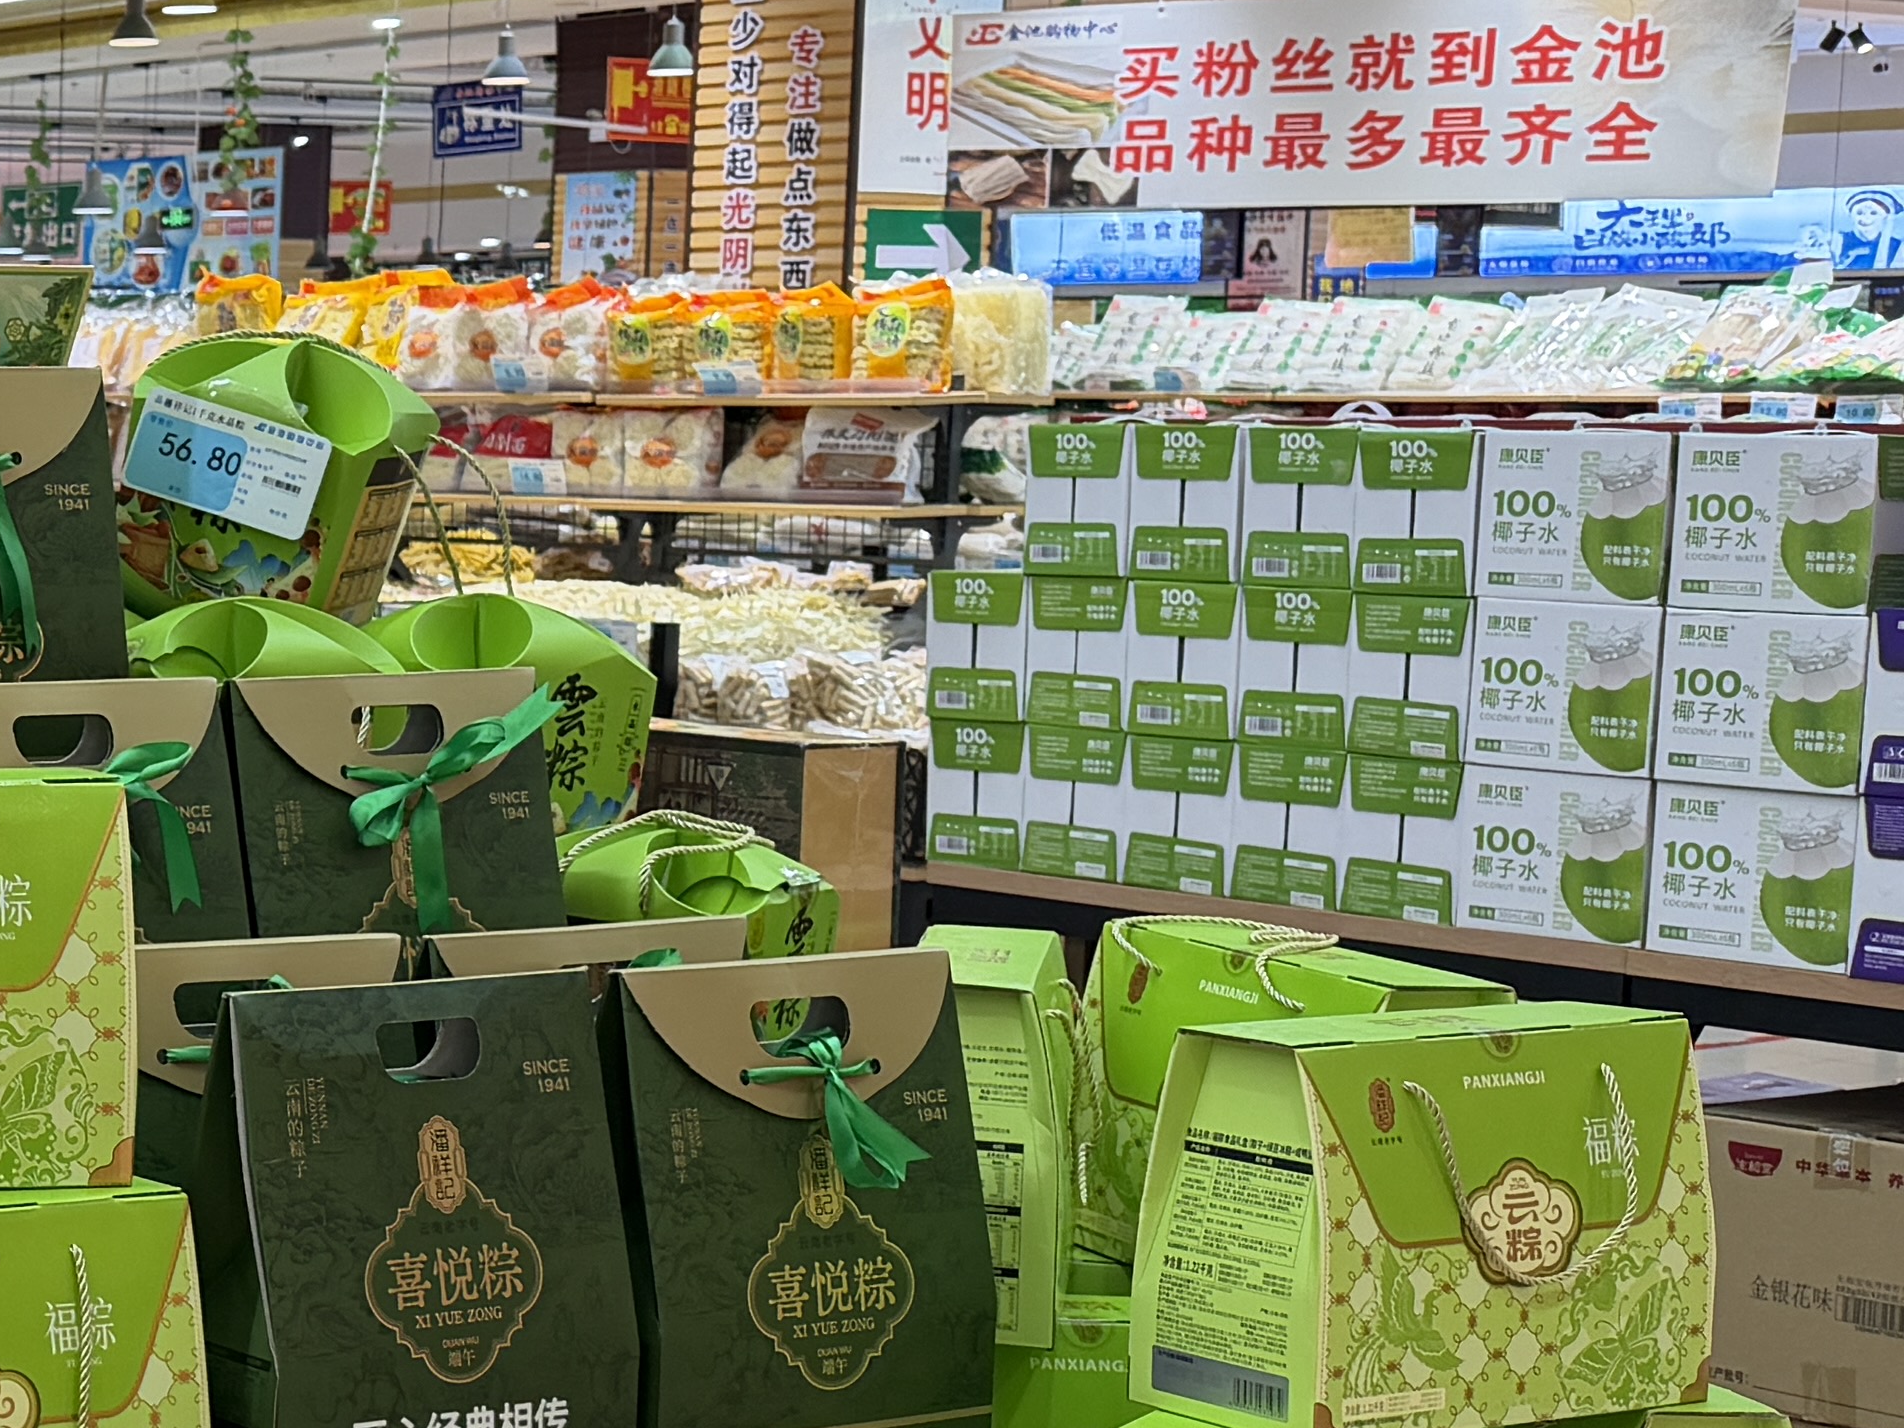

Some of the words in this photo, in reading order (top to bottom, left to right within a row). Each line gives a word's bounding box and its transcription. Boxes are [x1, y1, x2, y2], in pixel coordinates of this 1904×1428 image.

[1118, 18, 1669, 101] 买粉丝就到金池
[1111, 102, 1659, 177] 品种最多最齐全
[780, 25, 824, 290] 专注做点东西
[158, 432, 242, 476] 56.80
[1499, 448, 1545, 465] 康贝臣
[1692, 450, 1741, 466] 康贝臣
[44, 484, 90, 496] SINCE
[57, 497, 90, 510] 1941
[1494, 490, 1572, 518] 100%
[1686, 494, 1771, 523] 100%
[1493, 521, 1559, 543] 椰子水
[1685, 527, 1757, 549] 椰子水
[1487, 615, 1532, 633] 康贝臣
[1680, 624, 1729, 642] 康贝臣
[1481, 658, 1559, 687] 100%
[1673, 669, 1759, 700] 100%
[1481, 689, 1546, 711] 椰子水
[1672, 701, 1745, 724] 椰子水
[489, 792, 530, 804] SINCE
[1477, 784, 1524, 802] 康贝臣
[501, 806, 530, 820] 1941
[1473, 826, 1552, 857] 100%
[1472, 855, 1539, 880] 椰子水
[1664, 841, 1749, 874] 100%
[1662, 873, 1736, 898] 椰子水
[1198, 980, 1259, 1003] PANXIANGJI
[523, 1059, 570, 1076] SINCE
[1462, 1070, 1546, 1088] PANXIANGJI
[537, 1077, 570, 1093] 1941
[903, 1090, 948, 1105] SINCE
[917, 1108, 948, 1122] 1941
[387, 1243, 524, 1310] 喜悦粽
[766, 1262, 896, 1321] 喜悦粽
[1749, 1274, 1833, 1313] 金银花味
[416, 1314, 431, 1329] XI
[436, 1310, 463, 1326] YUE
[468, 1306, 502, 1323] ZONG
[793, 1323, 807, 1339] XI
[811, 1321, 838, 1337] YUE
[841, 1316, 875, 1334] ZONG
